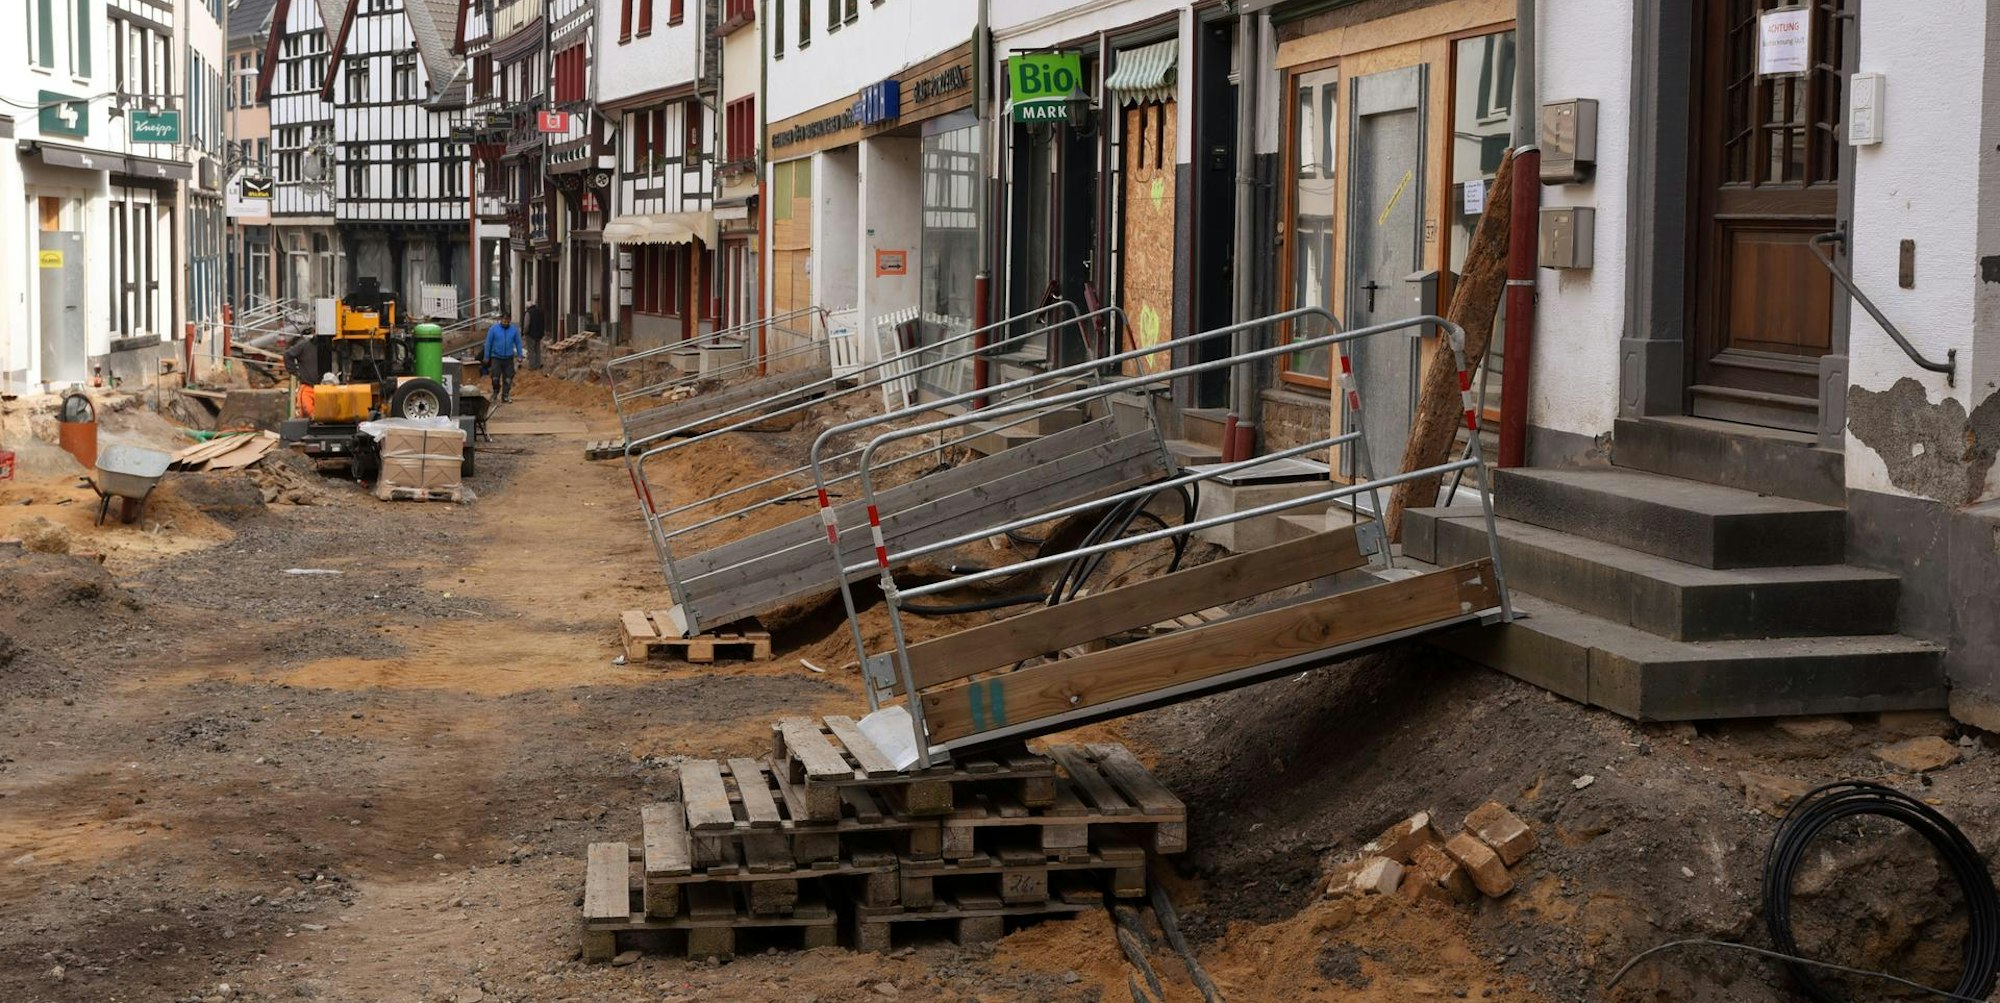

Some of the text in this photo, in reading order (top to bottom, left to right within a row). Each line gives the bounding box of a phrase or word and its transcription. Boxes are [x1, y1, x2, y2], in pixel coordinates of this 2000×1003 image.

[1767, 21, 1800, 33] ACHTUNG
[1019, 63, 1074, 94] Bio
[1023, 105, 1068, 119] MARK
[134, 120, 172, 136] Kneipp
